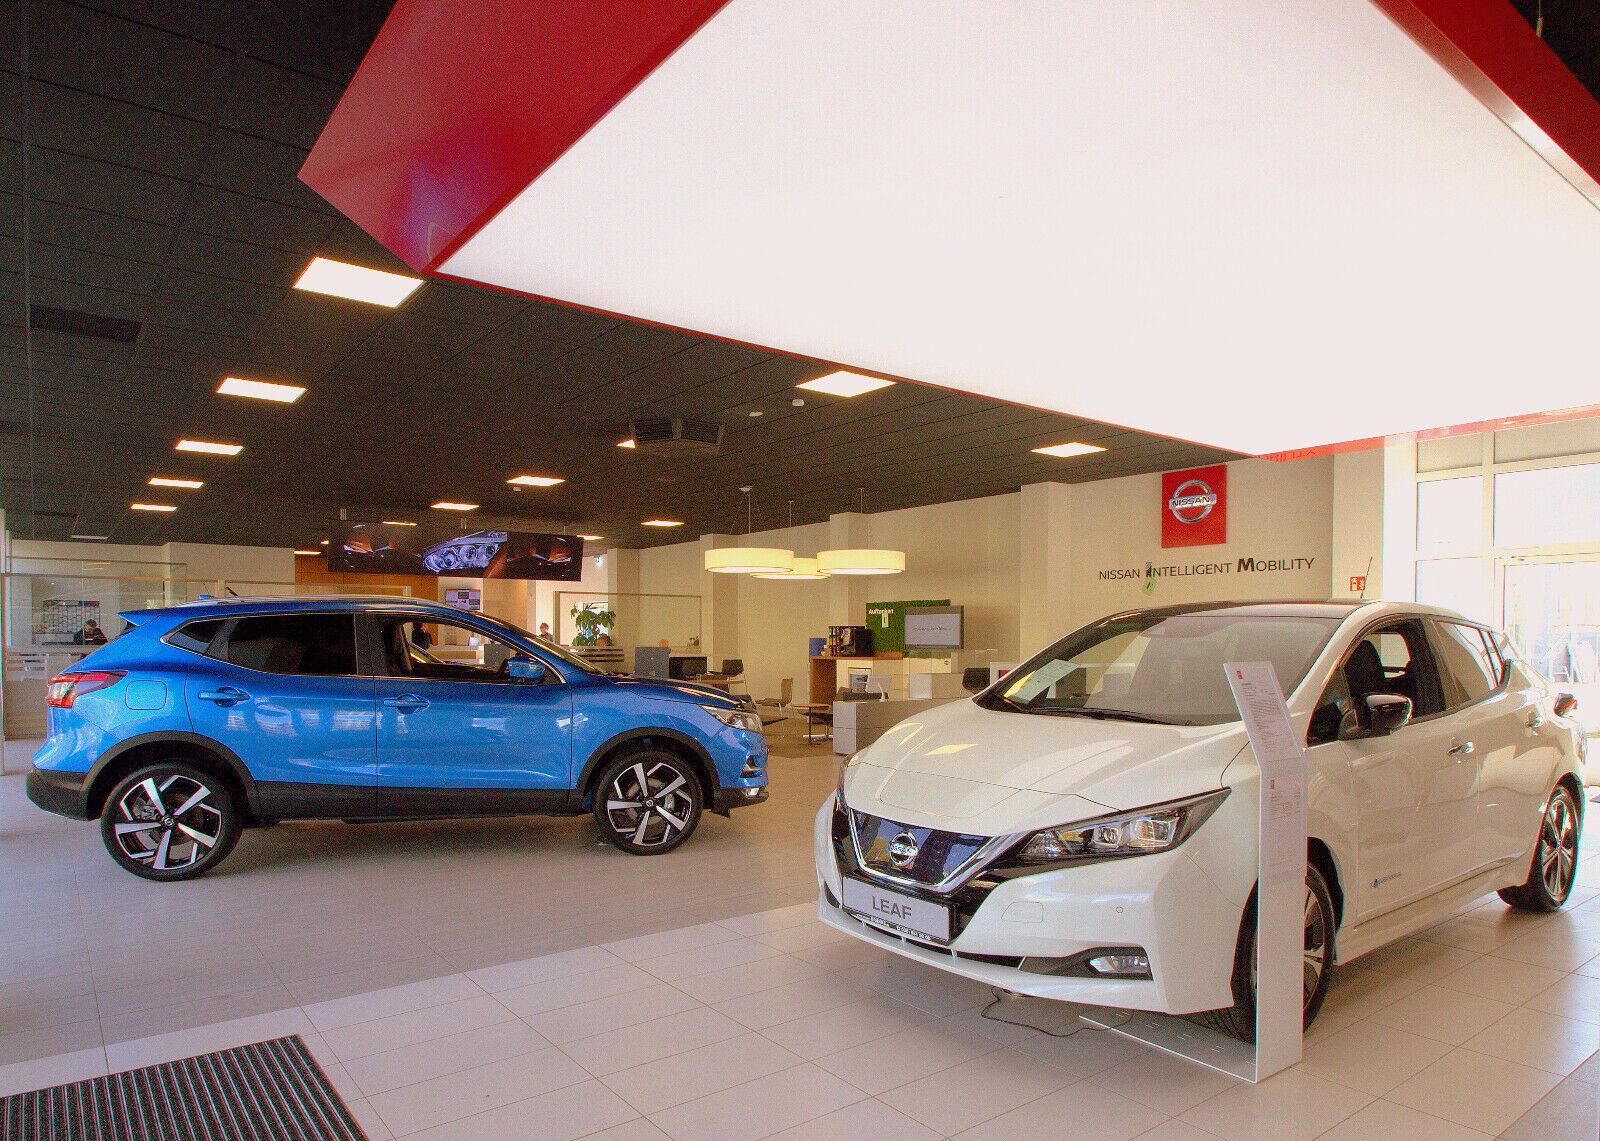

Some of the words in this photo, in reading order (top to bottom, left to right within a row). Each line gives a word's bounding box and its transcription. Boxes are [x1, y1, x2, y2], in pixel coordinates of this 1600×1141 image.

[1172, 496, 1210, 507] NISSAN
[1099, 568, 1140, 580] NISSAN
[1145, 561, 1232, 578] INTELLIGENT
[1237, 557, 1315, 573] MOBILITY
[872, 895, 912, 919] LEAF
